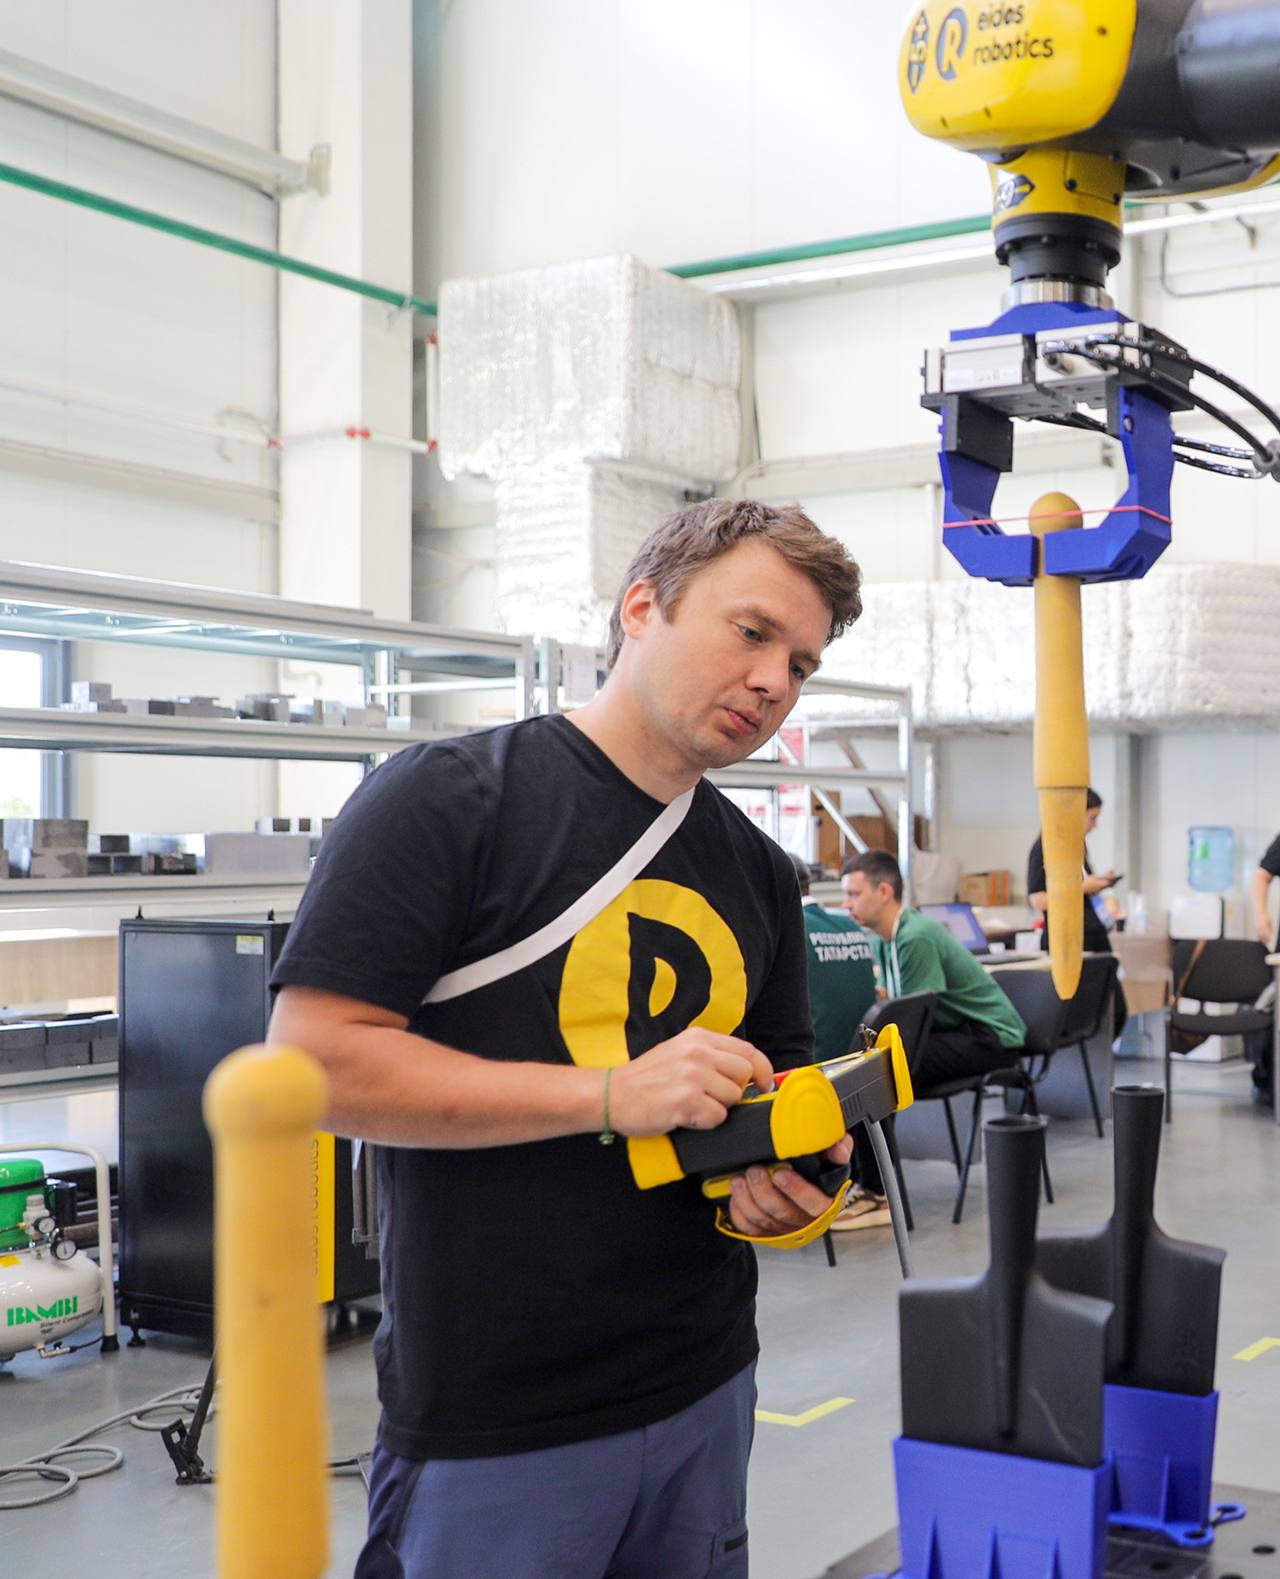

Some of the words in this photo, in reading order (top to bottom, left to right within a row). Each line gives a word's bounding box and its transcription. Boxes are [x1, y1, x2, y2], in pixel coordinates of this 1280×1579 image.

[977, 2, 1024, 31] eidos
[973, 32, 1054, 65] robotics
[7, 1296, 79, 1327] BAMBI
